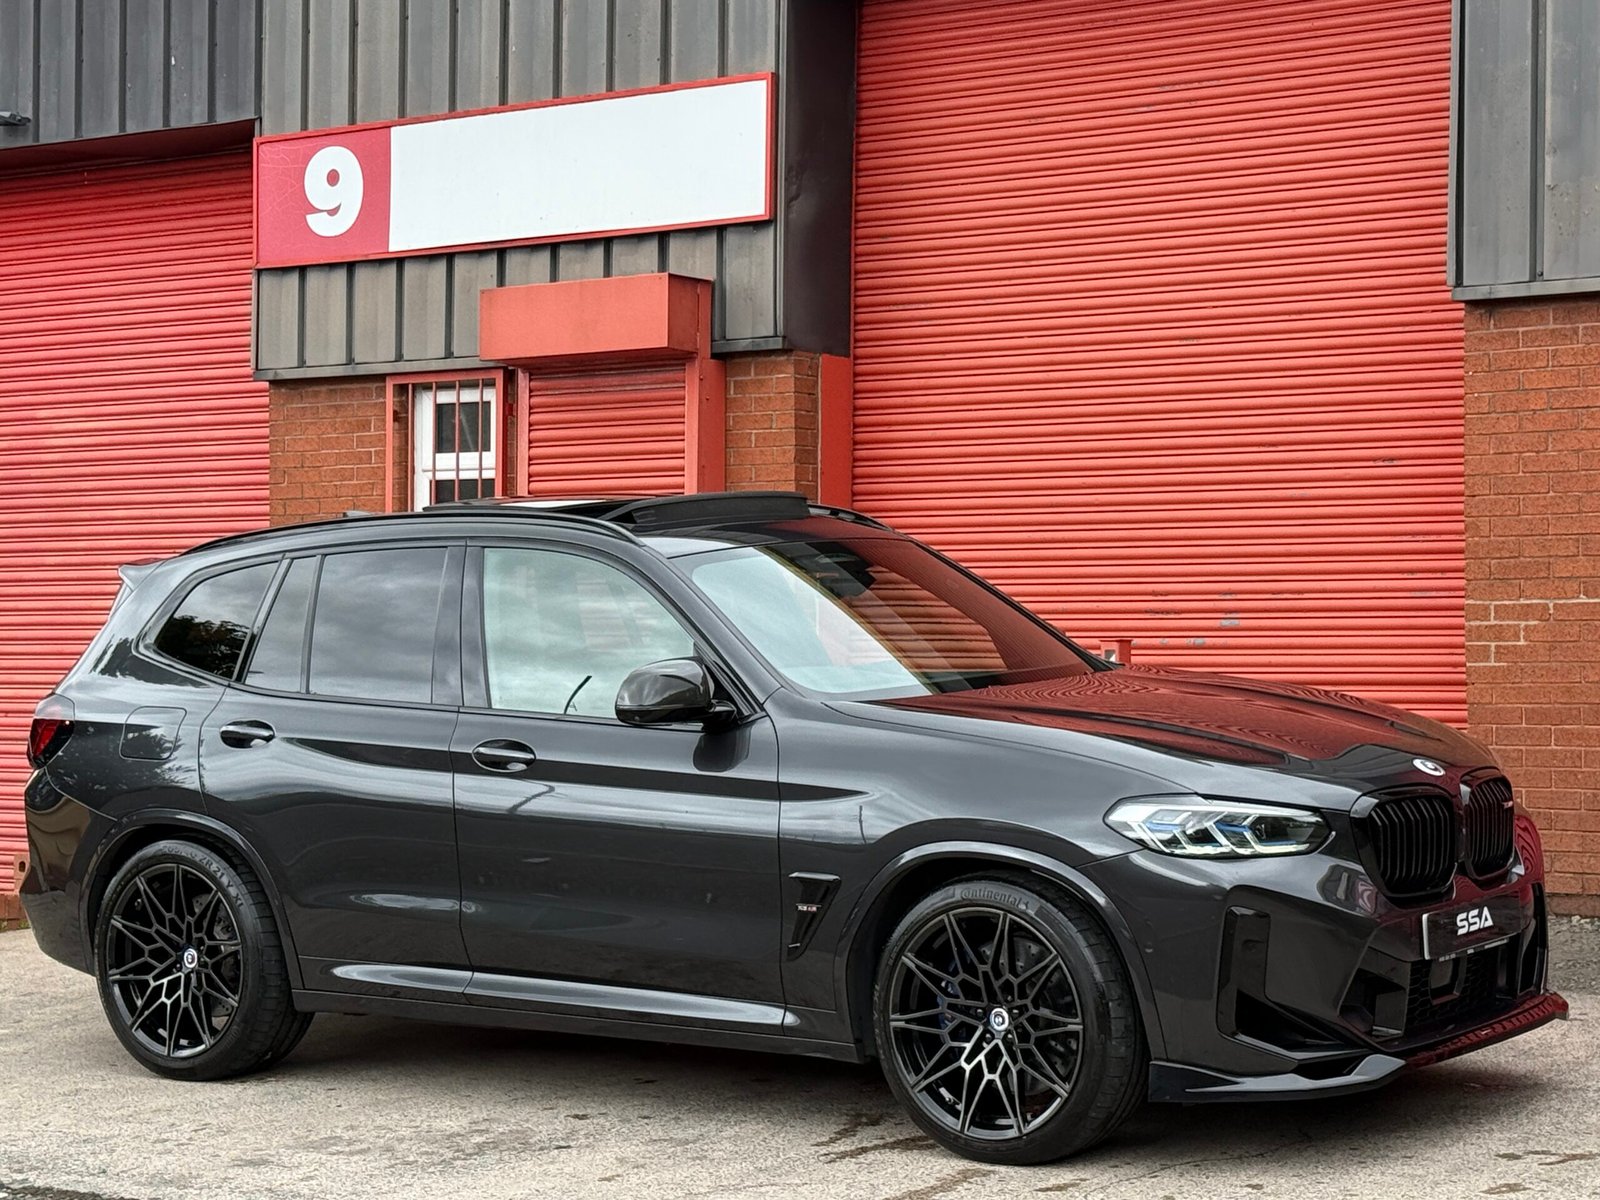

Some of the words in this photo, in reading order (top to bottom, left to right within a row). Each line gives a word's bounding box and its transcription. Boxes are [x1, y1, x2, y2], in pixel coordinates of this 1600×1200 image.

[304, 146, 364, 237] 9
[960, 887, 1022, 909] Continental
[1456, 906, 1494, 936] SSA
